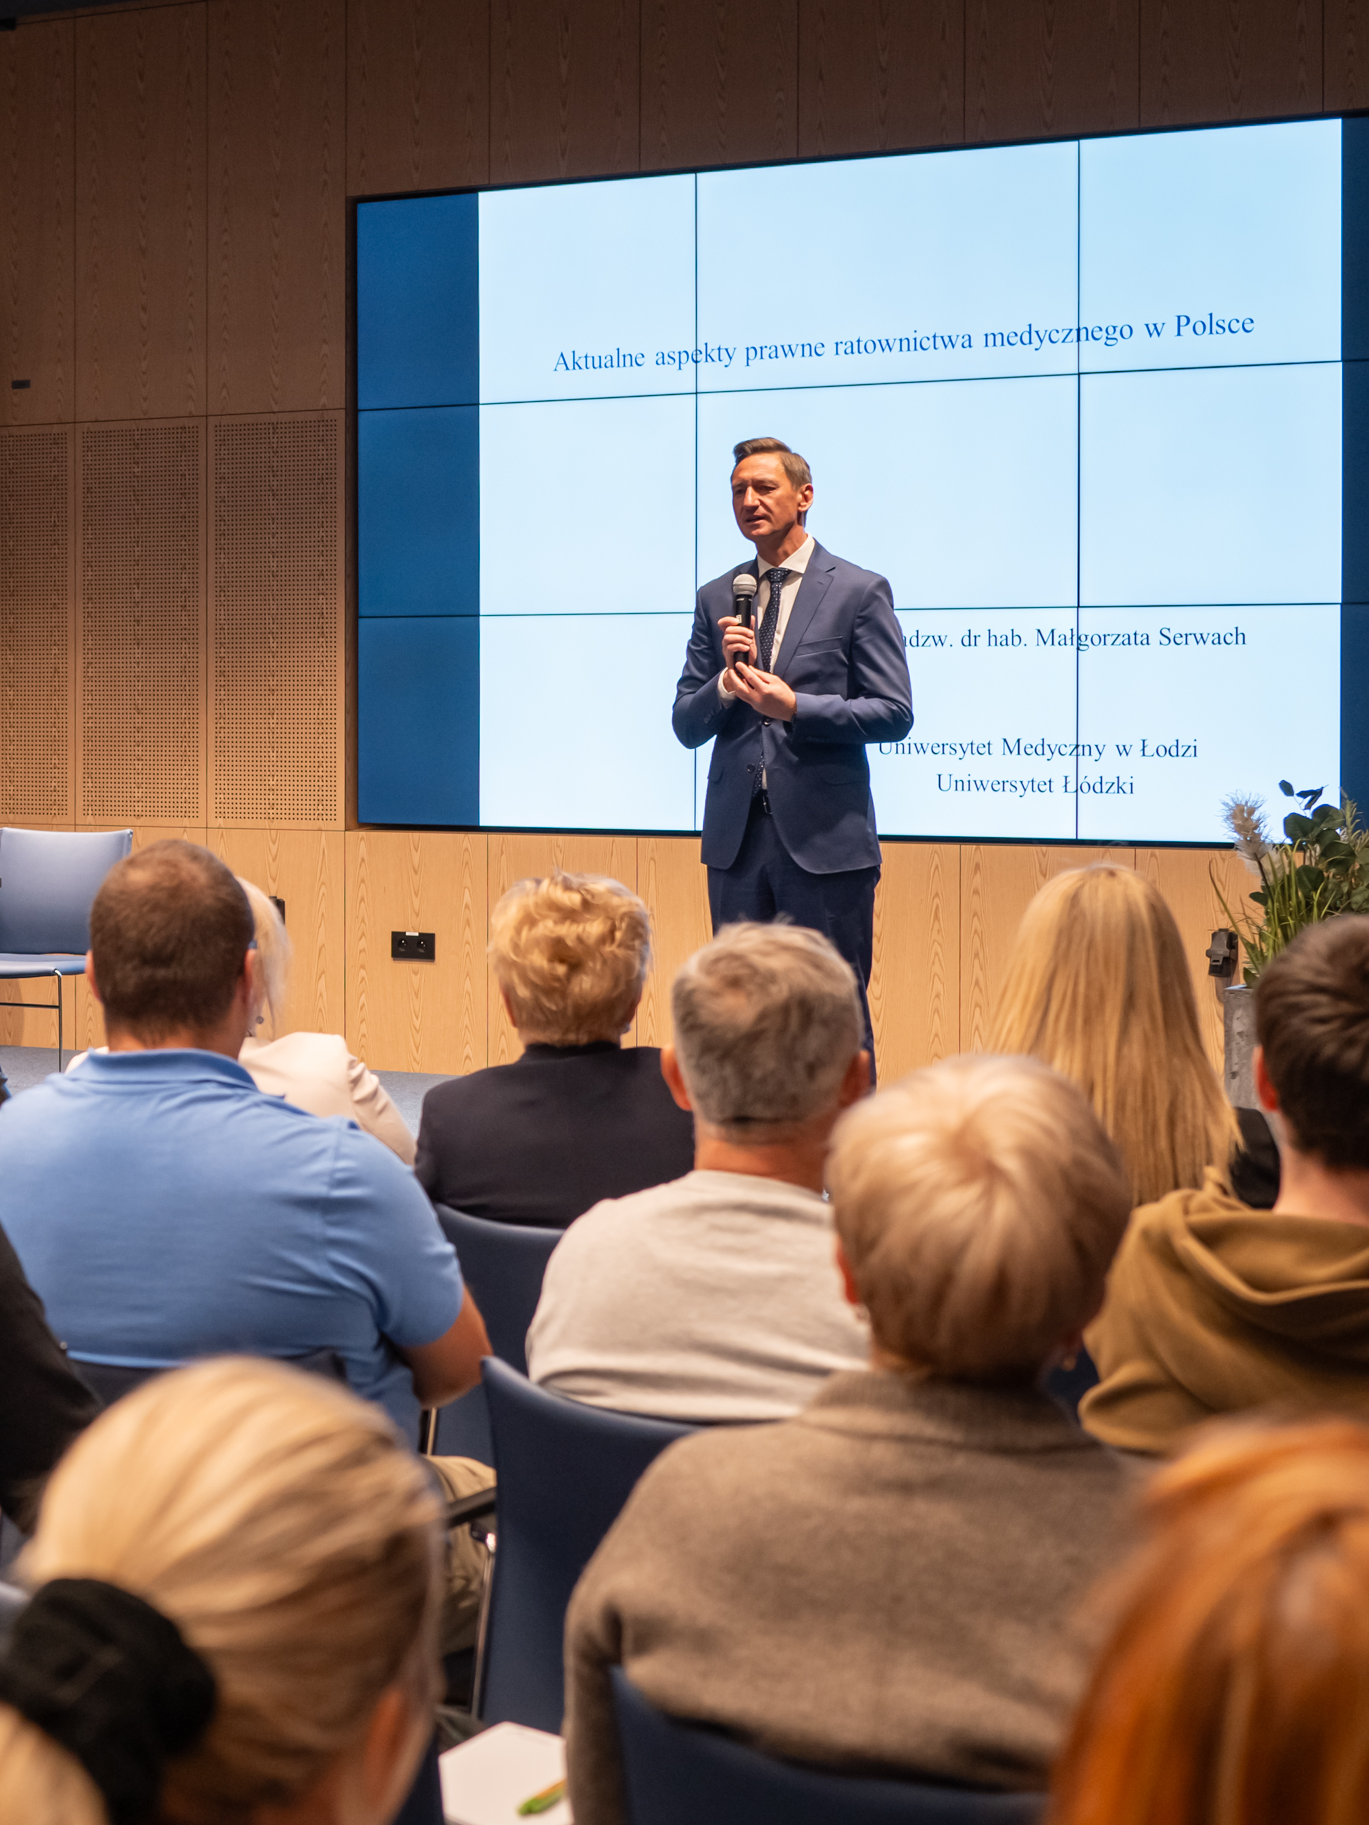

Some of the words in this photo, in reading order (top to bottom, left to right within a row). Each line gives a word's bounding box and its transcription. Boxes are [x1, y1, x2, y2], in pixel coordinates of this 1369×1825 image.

[553, 348, 645, 372] Aktualne
[655, 342, 737, 371] aspekty
[745, 340, 826, 367] prawne
[834, 329, 973, 356] ratownictwa
[983, 323, 1134, 351] medycznego
[1144, 322, 1166, 338] w
[1174, 312, 1255, 338] Polsce
[961, 628, 981, 647] dr
[987, 628, 1027, 647] hab.
[1035, 628, 1151, 652] Małgorzata
[1158, 626, 1247, 646] Serwach
[879, 736, 993, 761] Uniwersytet
[1001, 738, 1106, 761] Medyczny
[1115, 742, 1133, 757] w
[1139, 739, 1198, 758] Łodzi
[936, 773, 1054, 797] Uniwersytet
[1061, 774, 1135, 794] Łódzki
